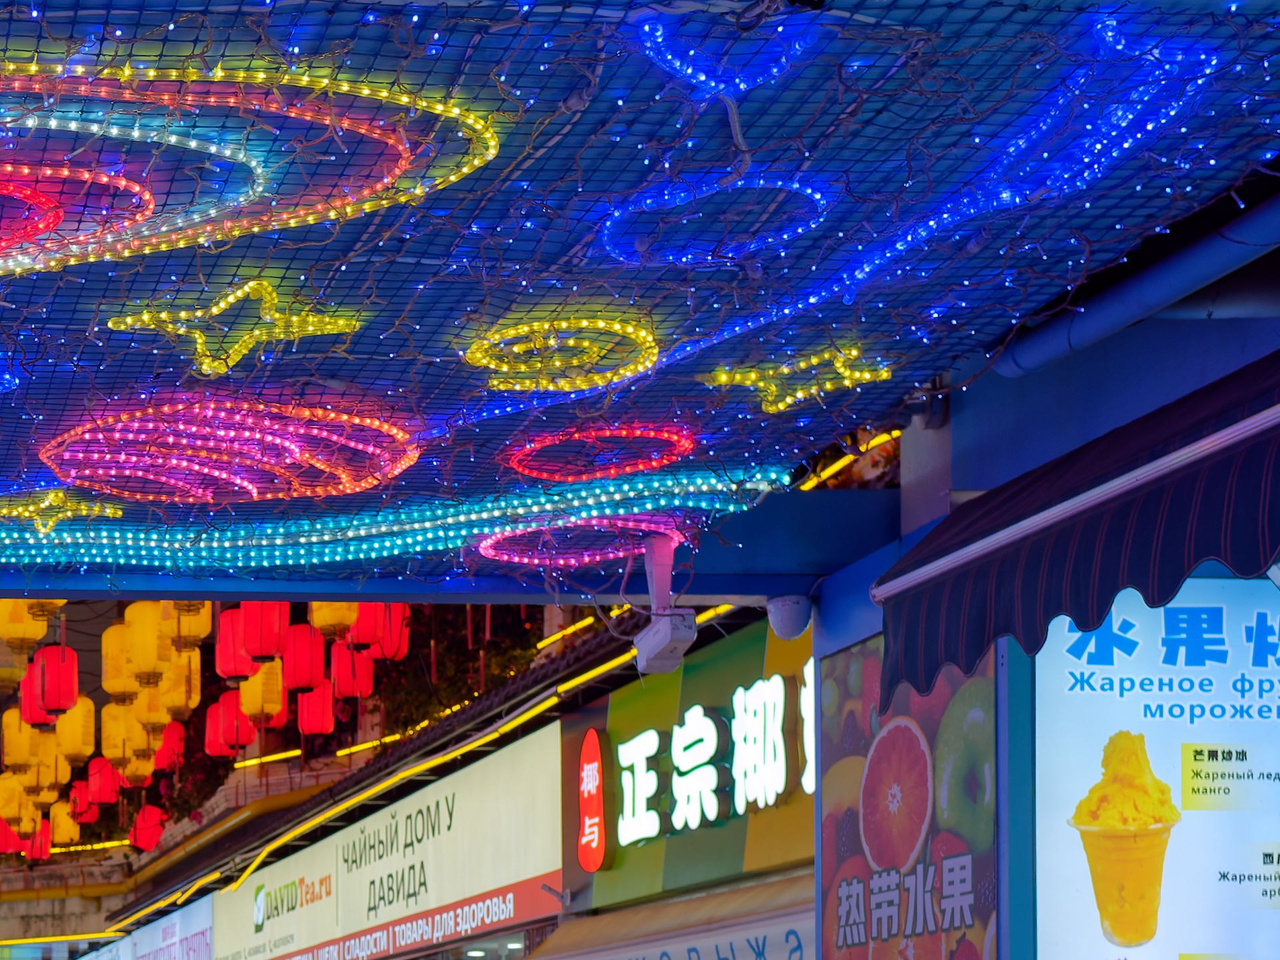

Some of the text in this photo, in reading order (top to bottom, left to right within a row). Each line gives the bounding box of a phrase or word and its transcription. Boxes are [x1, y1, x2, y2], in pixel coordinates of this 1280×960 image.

[1067, 671, 1280, 699] Жареное фр
[617, 656, 816, 848] 正宗椰
[1191, 768, 1254, 782] Жареный
[1191, 786, 1231, 796] манго
[342, 792, 456, 873] ЧАЙНЫЙ ДОМ У
[367, 861, 428, 920] ДАВИДА
[836, 853, 975, 948] 热带水果
[394, 917, 432, 947] ТОВАРЫ
[433, 910, 455, 944] ДЛЯ
[456, 892, 514, 936] ЗДОРОВЬЯ
